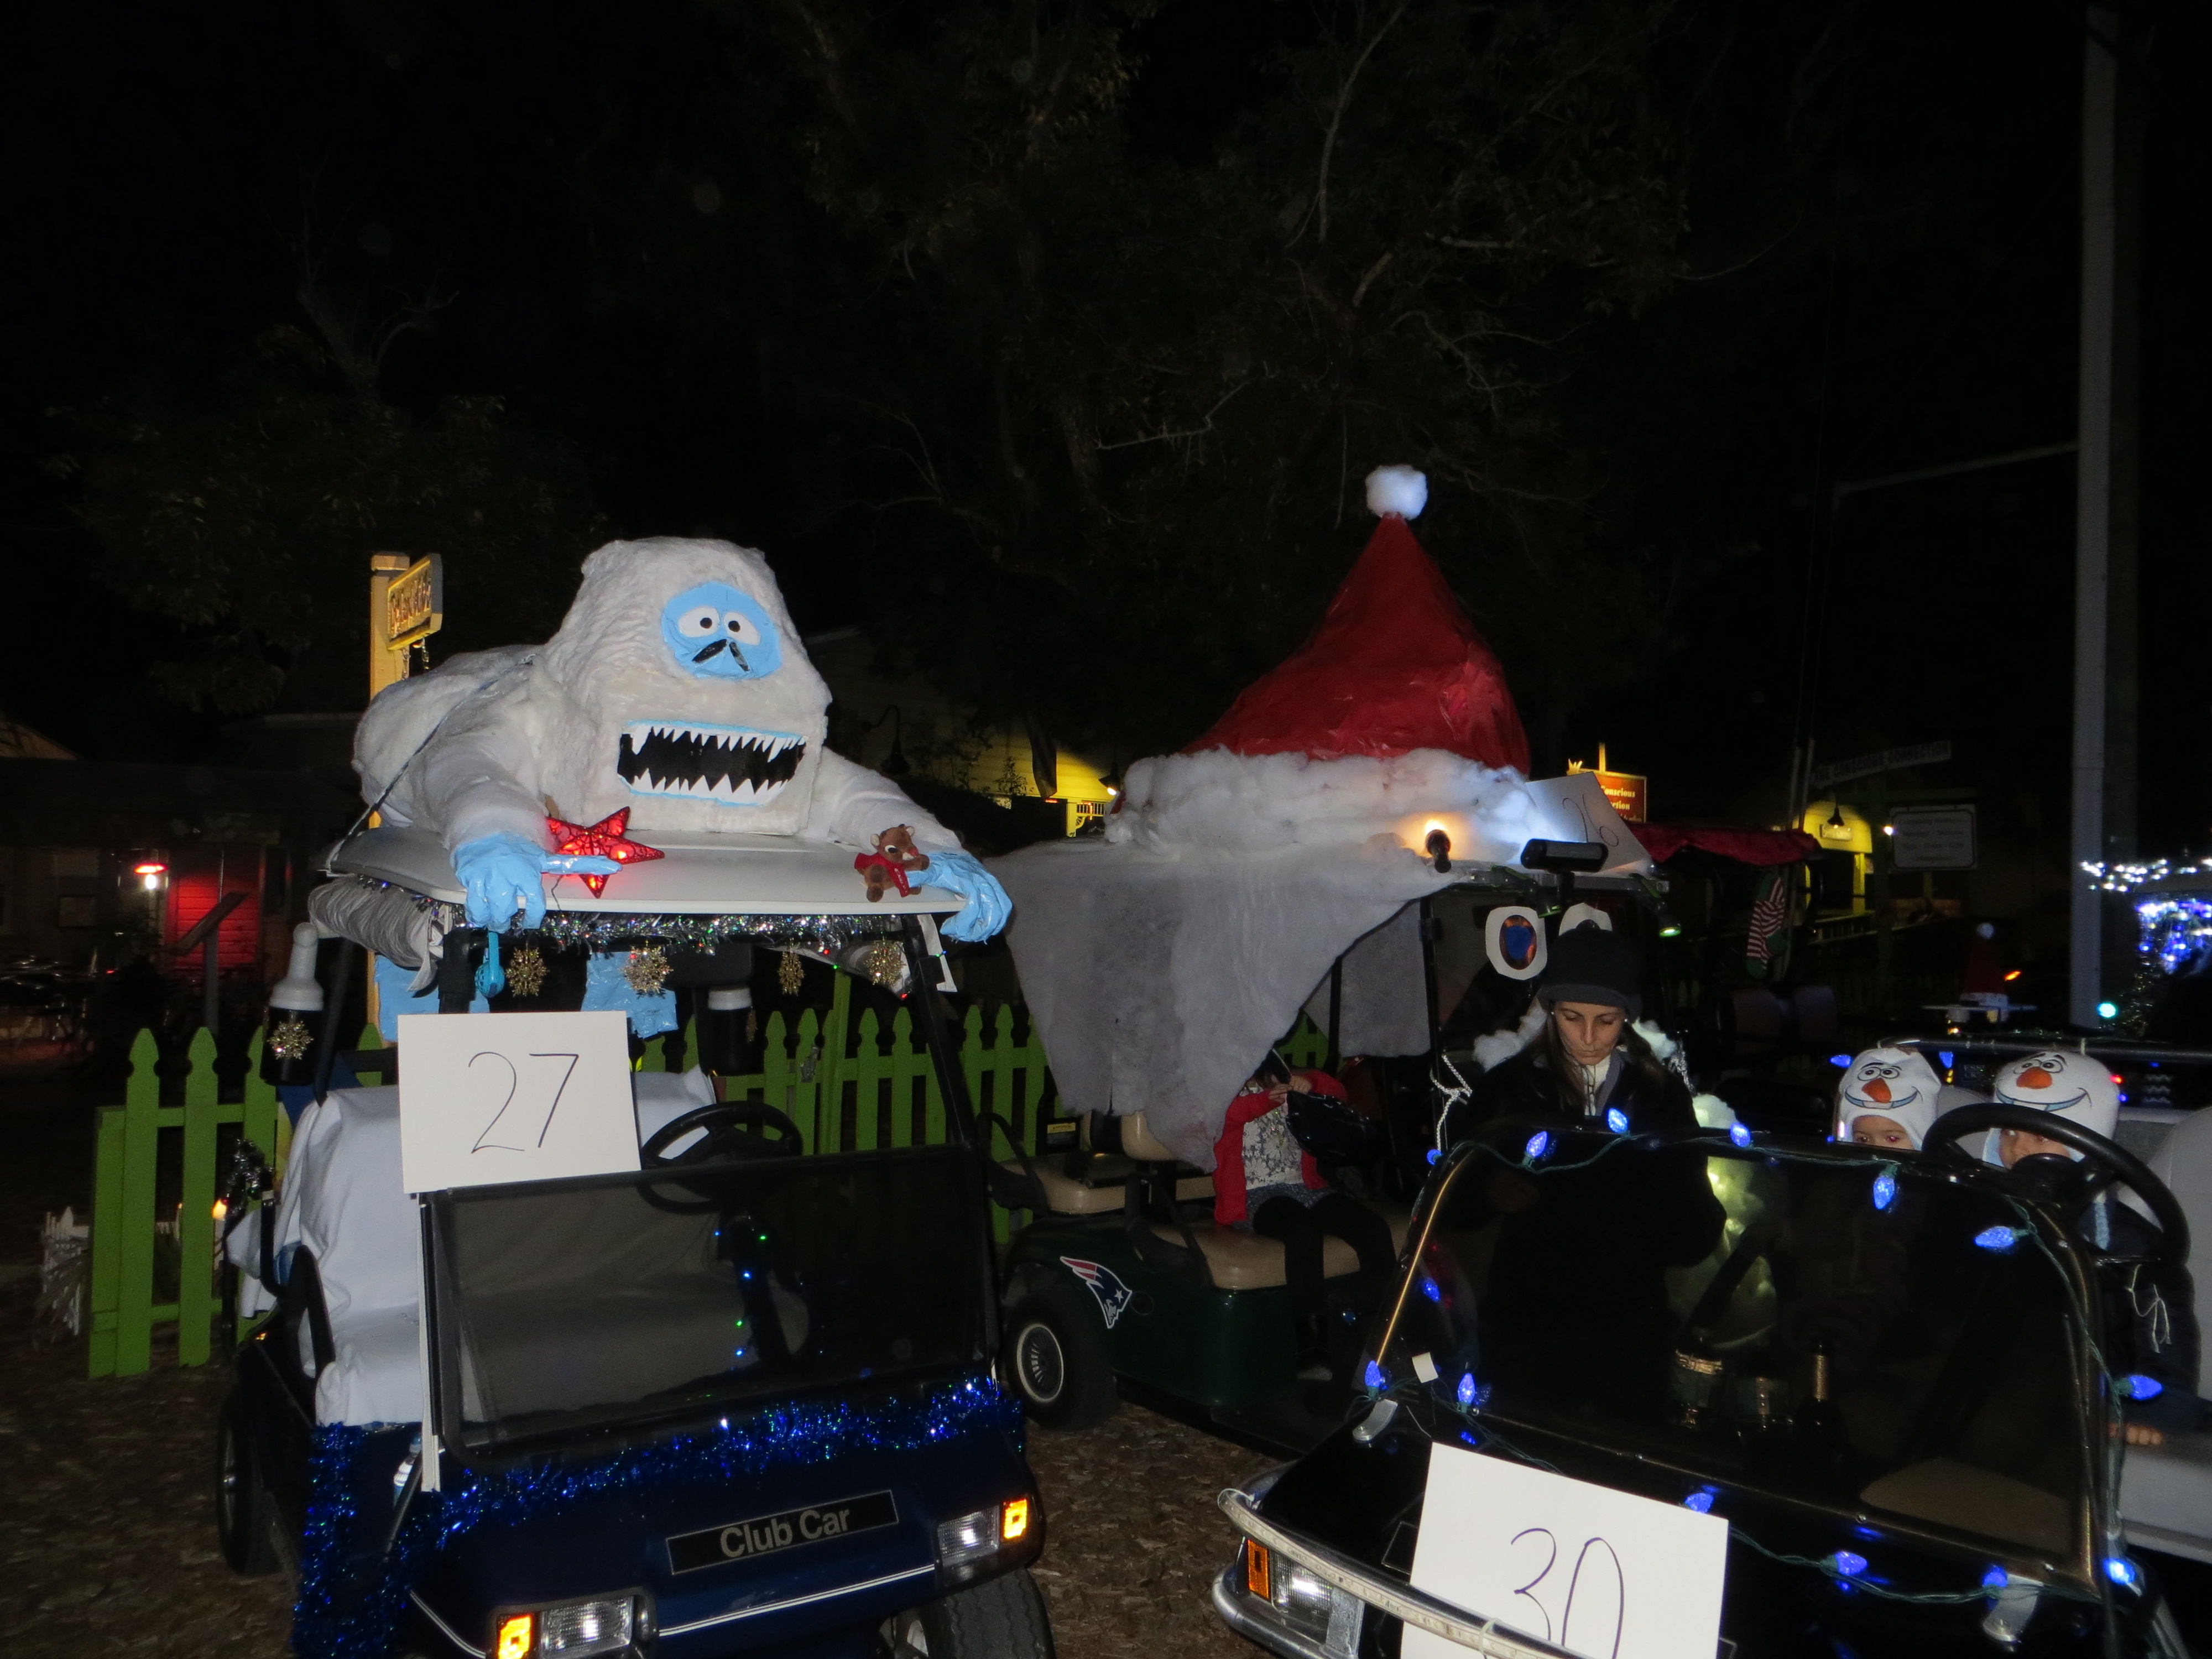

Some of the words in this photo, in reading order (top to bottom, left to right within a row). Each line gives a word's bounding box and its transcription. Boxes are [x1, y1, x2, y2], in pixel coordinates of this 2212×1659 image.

[468, 1051, 579, 1154] 27
[720, 1519, 793, 1558] Club
[799, 1509, 851, 1540] Car
[1510, 1527, 1625, 1659] 30
